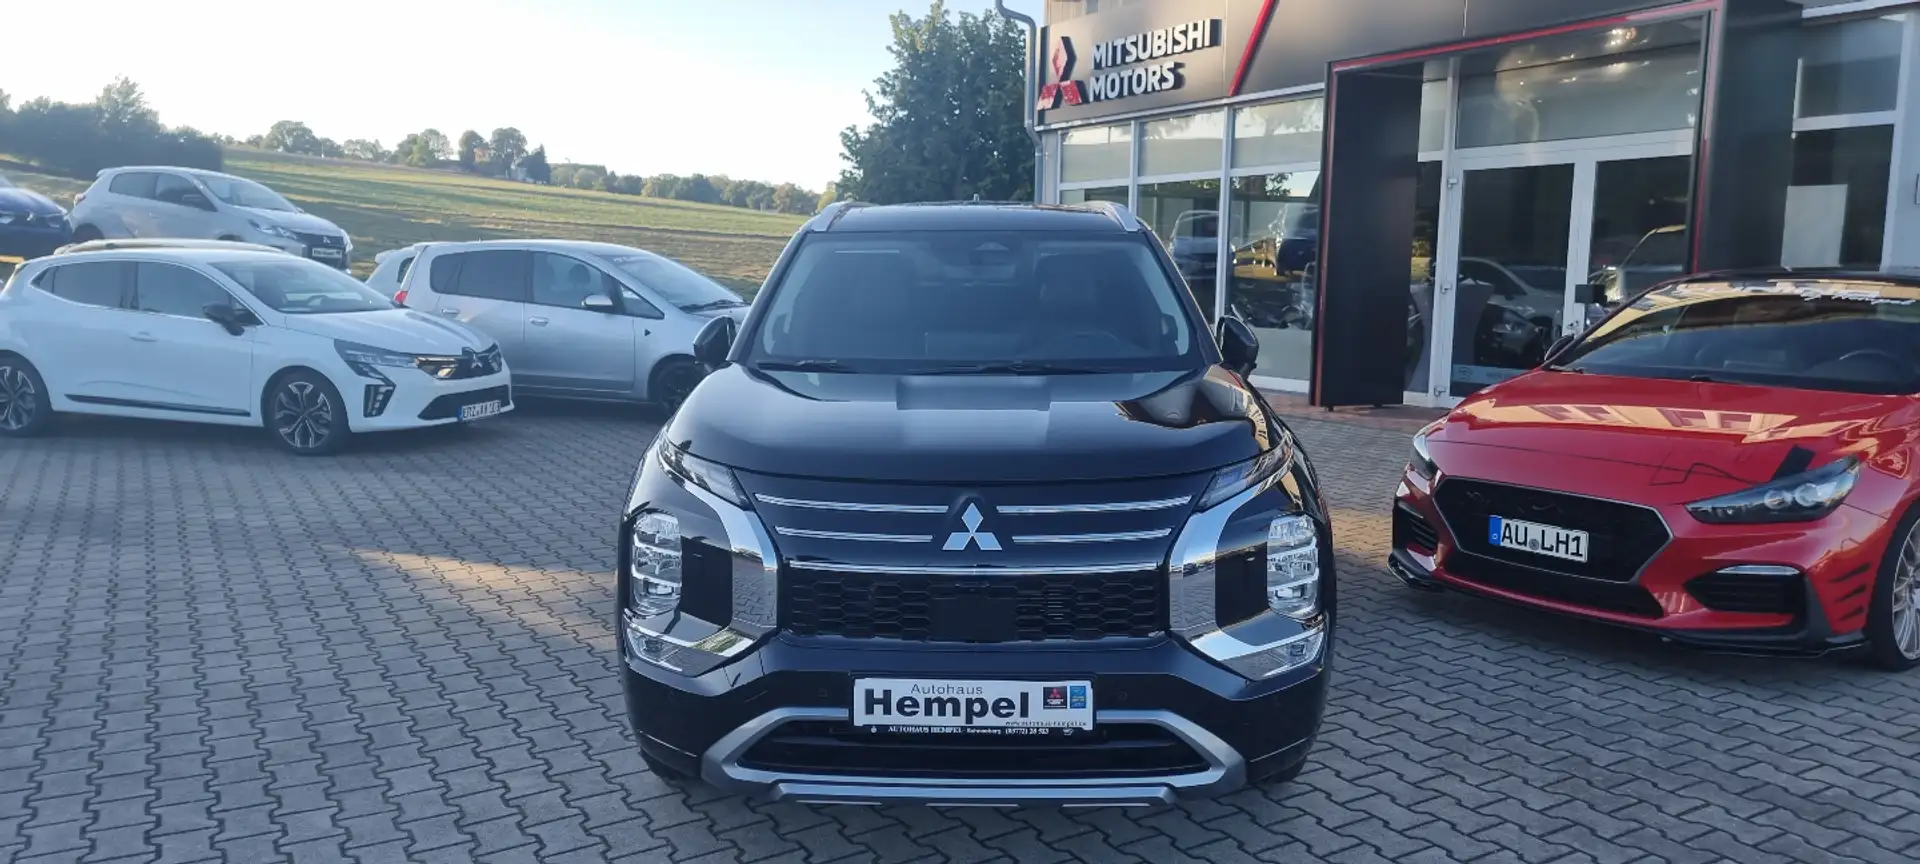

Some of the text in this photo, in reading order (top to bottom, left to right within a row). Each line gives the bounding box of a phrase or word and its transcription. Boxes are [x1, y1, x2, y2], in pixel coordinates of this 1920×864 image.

[1091, 18, 1212, 70] MITSUBISHI
[1089, 62, 1175, 103] MOTORS
[1501, 522, 1583, 557] AU LH1
[864, 688, 1030, 725] Hempel
[910, 684, 984, 696] Autohaus
[888, 726, 930, 734] AUTOHAUS
